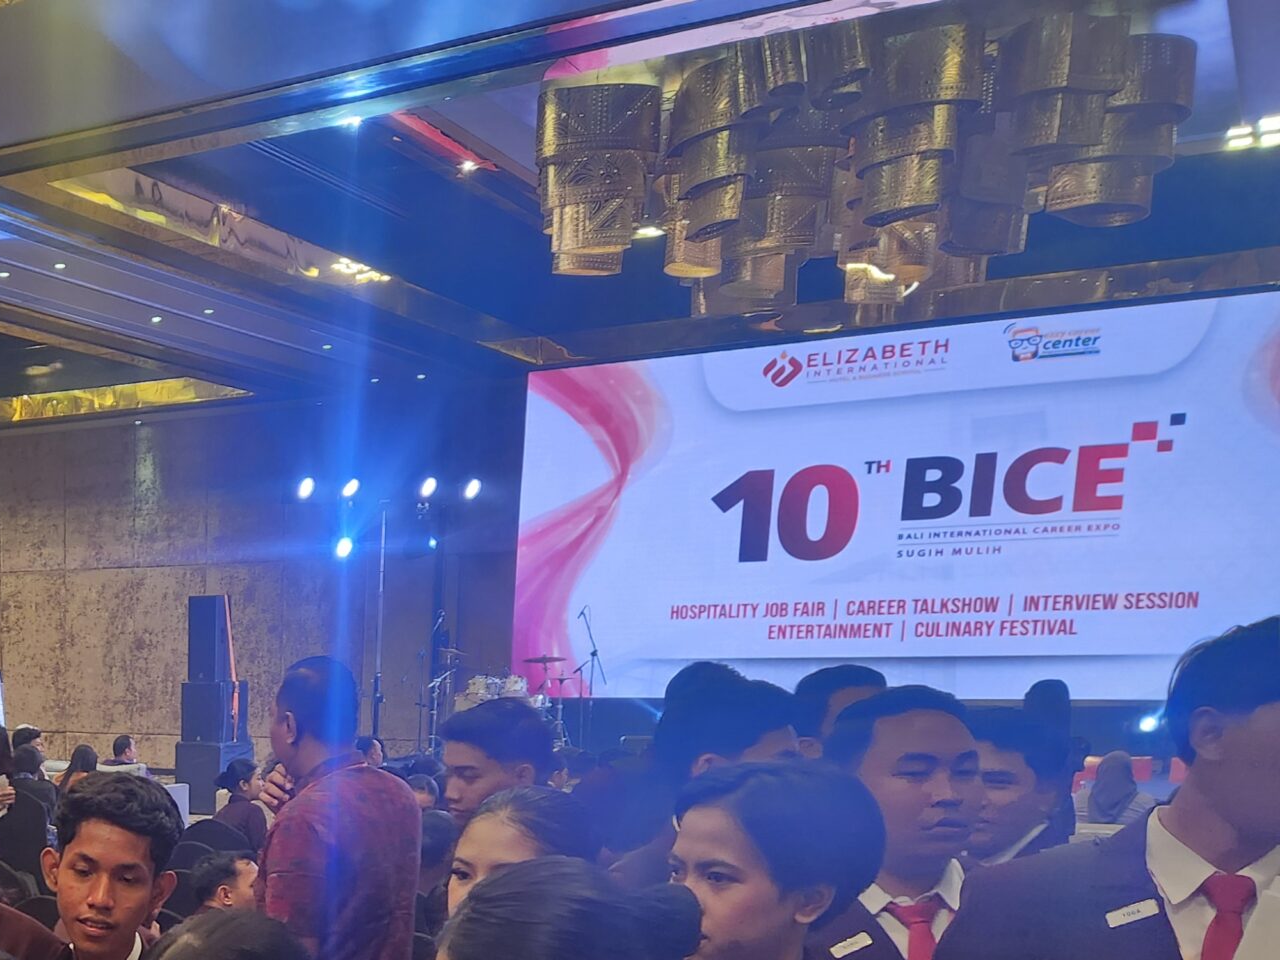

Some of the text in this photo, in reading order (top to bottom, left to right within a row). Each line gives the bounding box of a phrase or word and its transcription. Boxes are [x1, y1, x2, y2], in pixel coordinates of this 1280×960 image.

[806, 338, 950, 368] ELIZABETH
[1043, 335, 1101, 350] center
[806, 357, 948, 378] INTERNATIONAL
[711, 443, 1129, 562] 10 TH BICE
[897, 523, 1121, 541] BALI INTERNATIONAL CAREER EXPO
[896, 545, 1002, 558] SUGIH MULIH
[670, 591, 1199, 620] HOSPITALITY JOB FAIR CAREER TALKSHOW INTERVIEW SESSION
[768, 618, 1078, 640] ENTERTAINMENT CULINARY FESTIVAL
